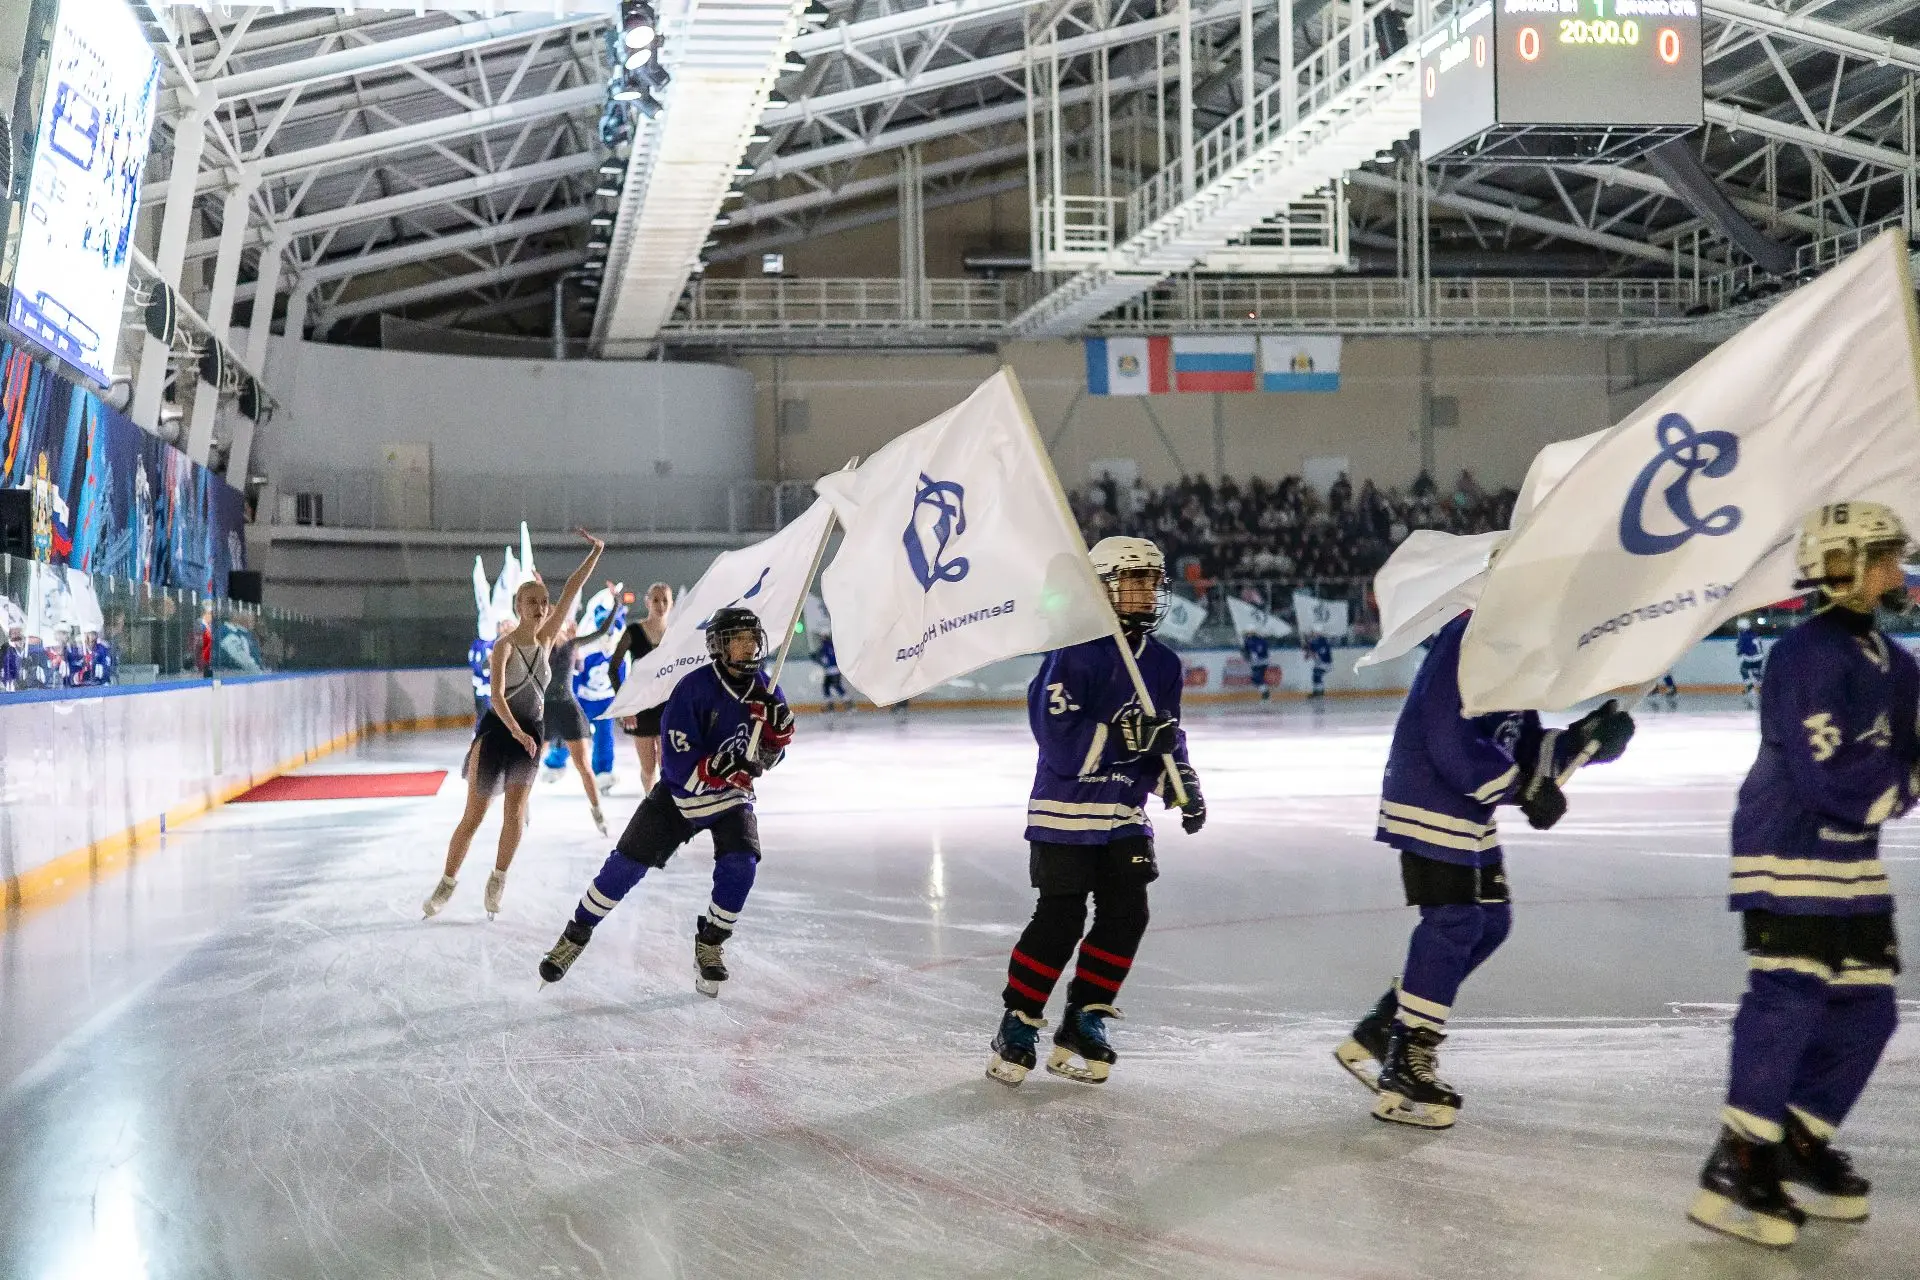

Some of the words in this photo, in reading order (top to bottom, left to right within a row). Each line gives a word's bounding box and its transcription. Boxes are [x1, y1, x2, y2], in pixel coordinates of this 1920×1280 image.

[1518, 26, 1541, 61] 0
[1559, 19, 1639, 45] 20:00.0
[1658, 28, 1680, 63] 0
